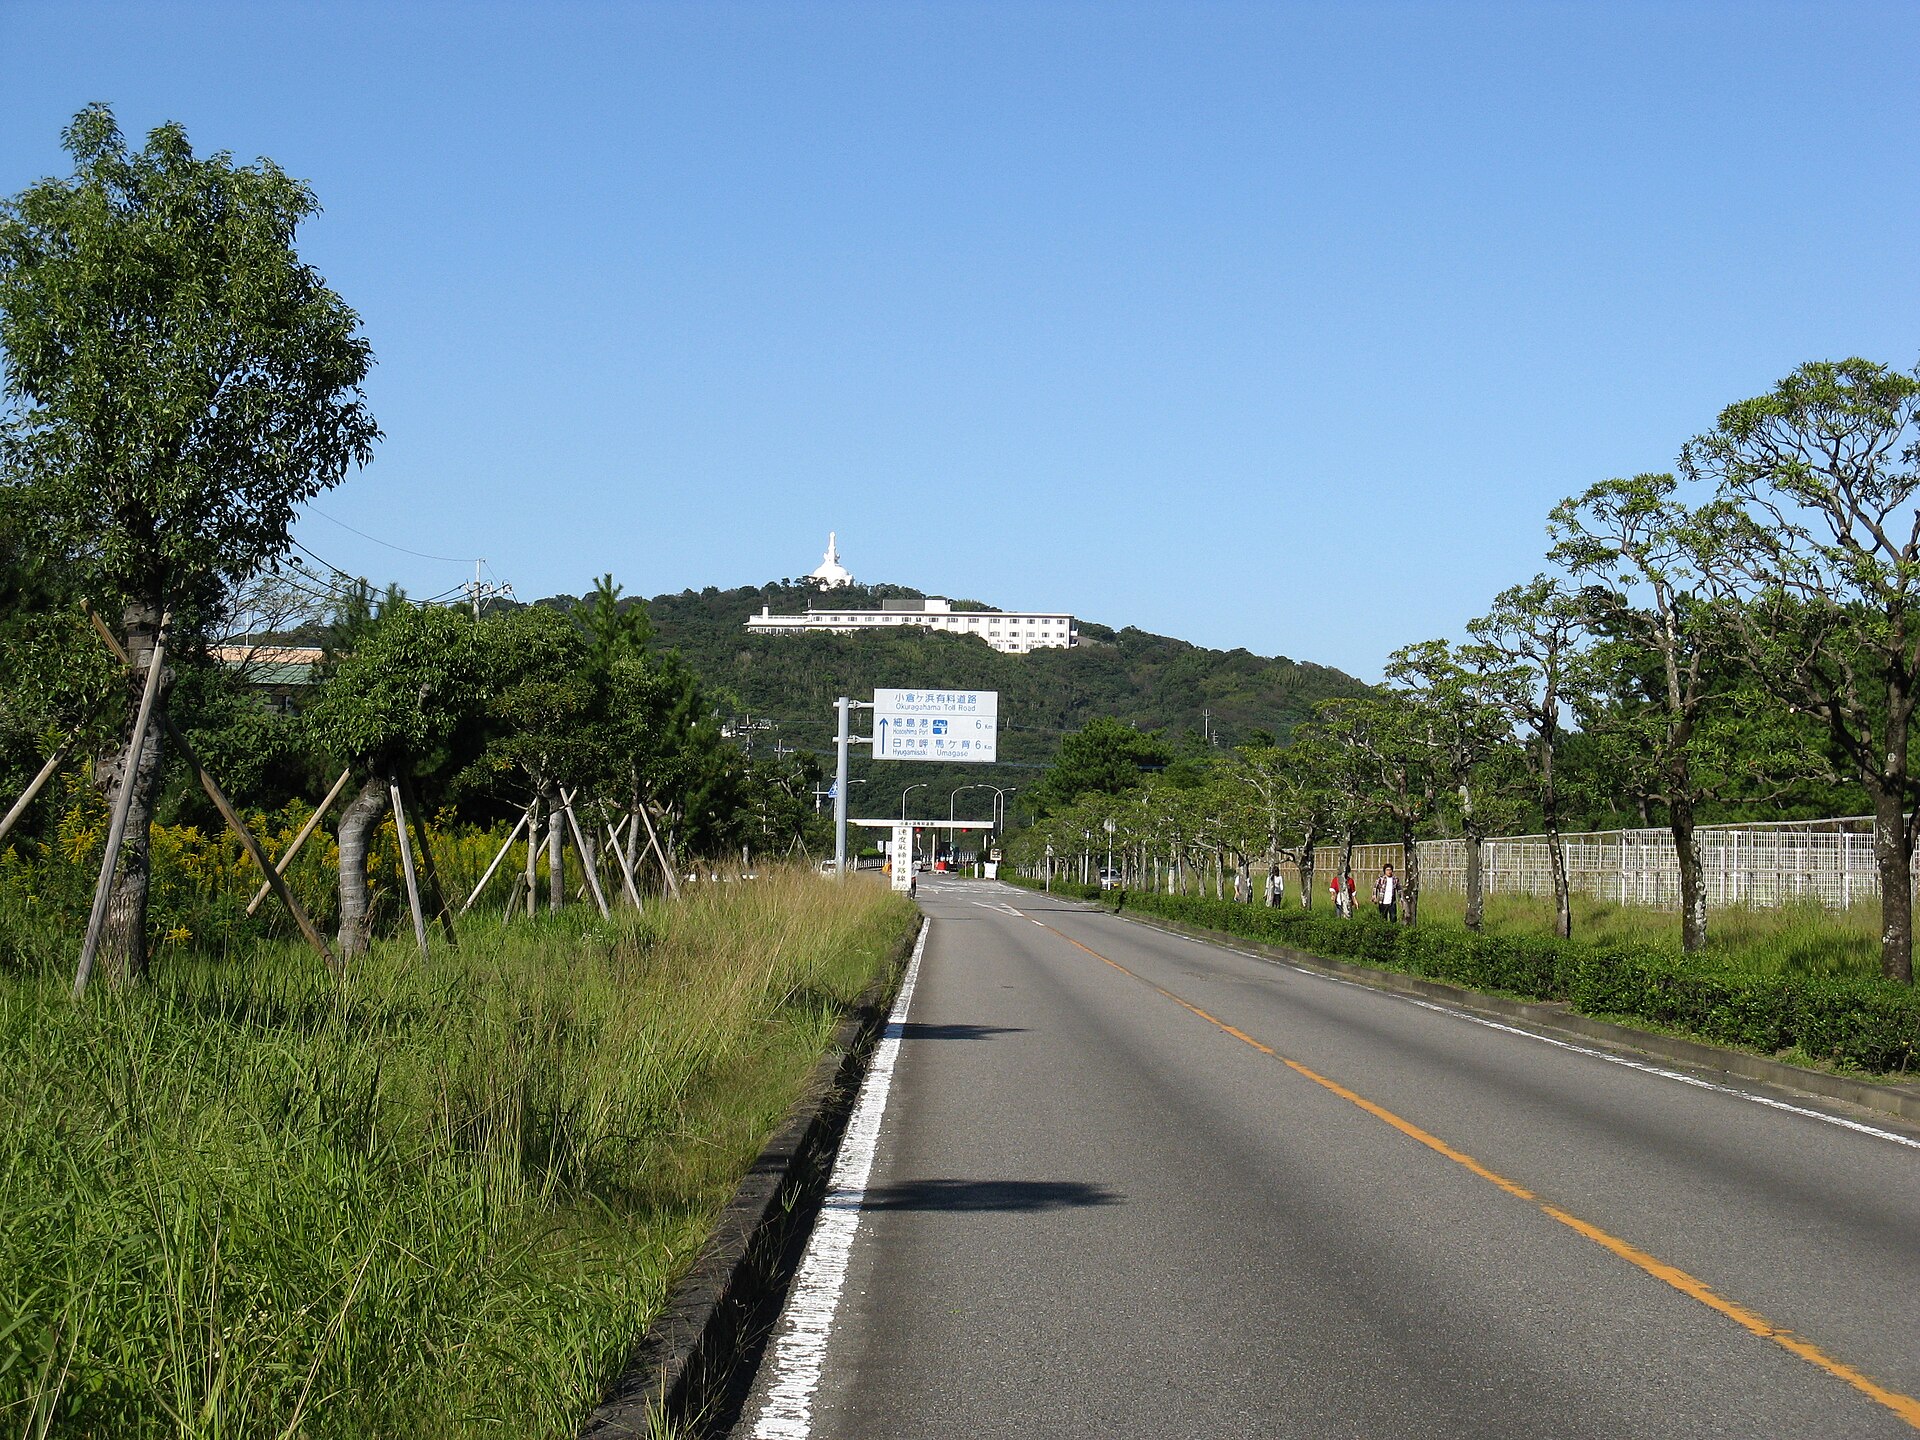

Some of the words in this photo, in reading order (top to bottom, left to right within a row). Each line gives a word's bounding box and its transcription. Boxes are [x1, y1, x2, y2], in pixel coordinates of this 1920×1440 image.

[896, 702, 940, 711] Okuragahama
[958, 704, 976, 712] Road
[893, 718, 928, 728] 細島港
[975, 719, 982, 730] 6
[975, 740, 982, 750] 6
[893, 748, 928, 756] Hyugamisaki
[936, 749, 969, 757] Umagase
